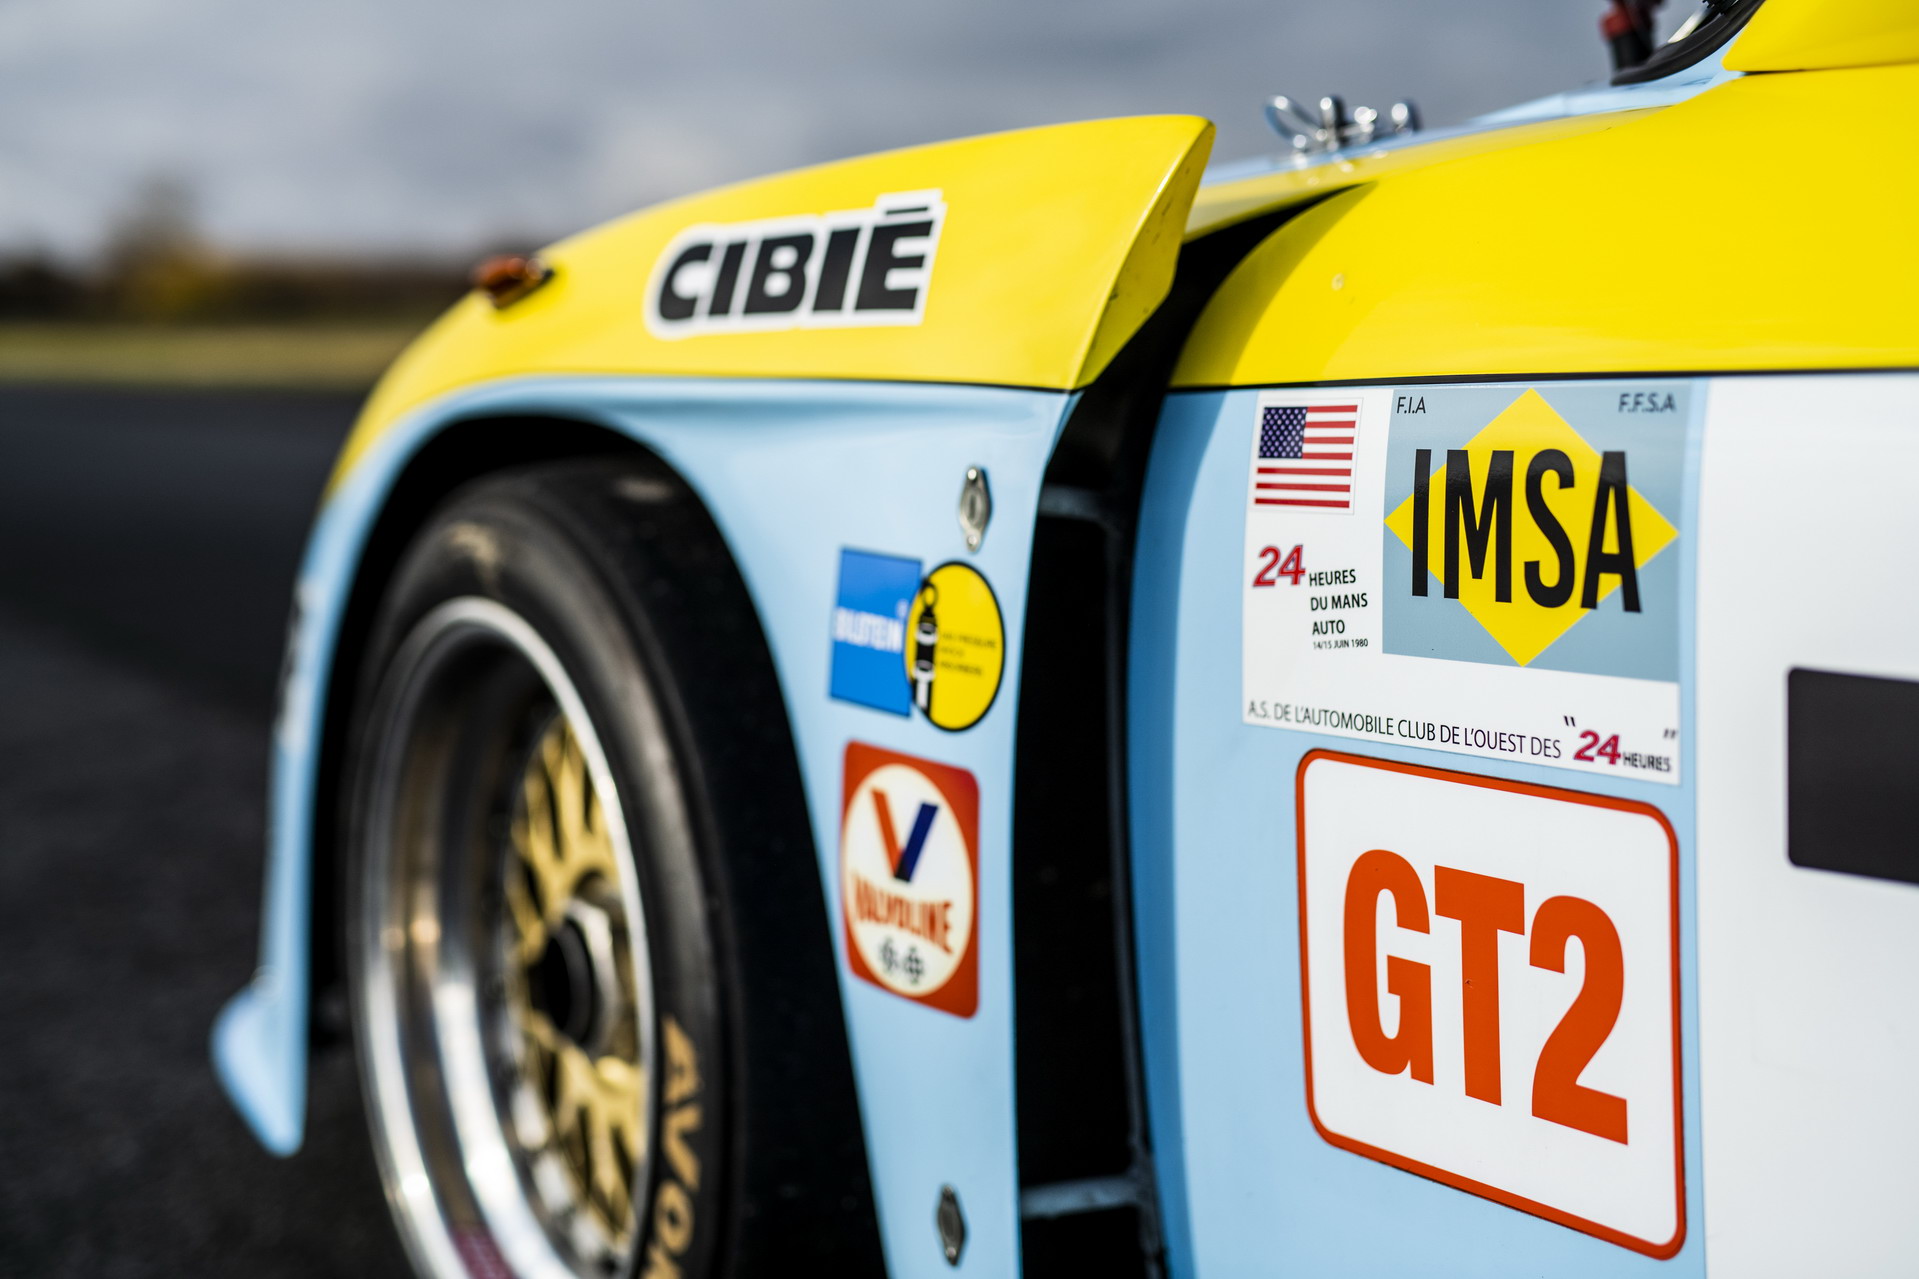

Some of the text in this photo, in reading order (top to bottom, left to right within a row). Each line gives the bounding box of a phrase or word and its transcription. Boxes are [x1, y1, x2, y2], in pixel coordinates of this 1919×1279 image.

[658, 205, 934, 321] CIBIÉ
[1396, 396, 1427, 414] F.I.A
[1411, 448, 1642, 614] IMSA
[1252, 544, 1356, 588] 24 HEURES
[1310, 593, 1368, 611] DU MANS
[1312, 619, 1345, 635] AUTO
[1333, 640, 1349, 649] JUIN
[1351, 638, 1369, 648] 1980
[1273, 702, 1292, 722] DE
[1294, 705, 1395, 736] L'AUTOMOBILE
[1397, 719, 1436, 741] CLUB
[1440, 724, 1461, 745] DE
[1464, 726, 1527, 754] L'OUEST
[1530, 736, 1562, 759] DES
[1343, 849, 1629, 1146] GT2
